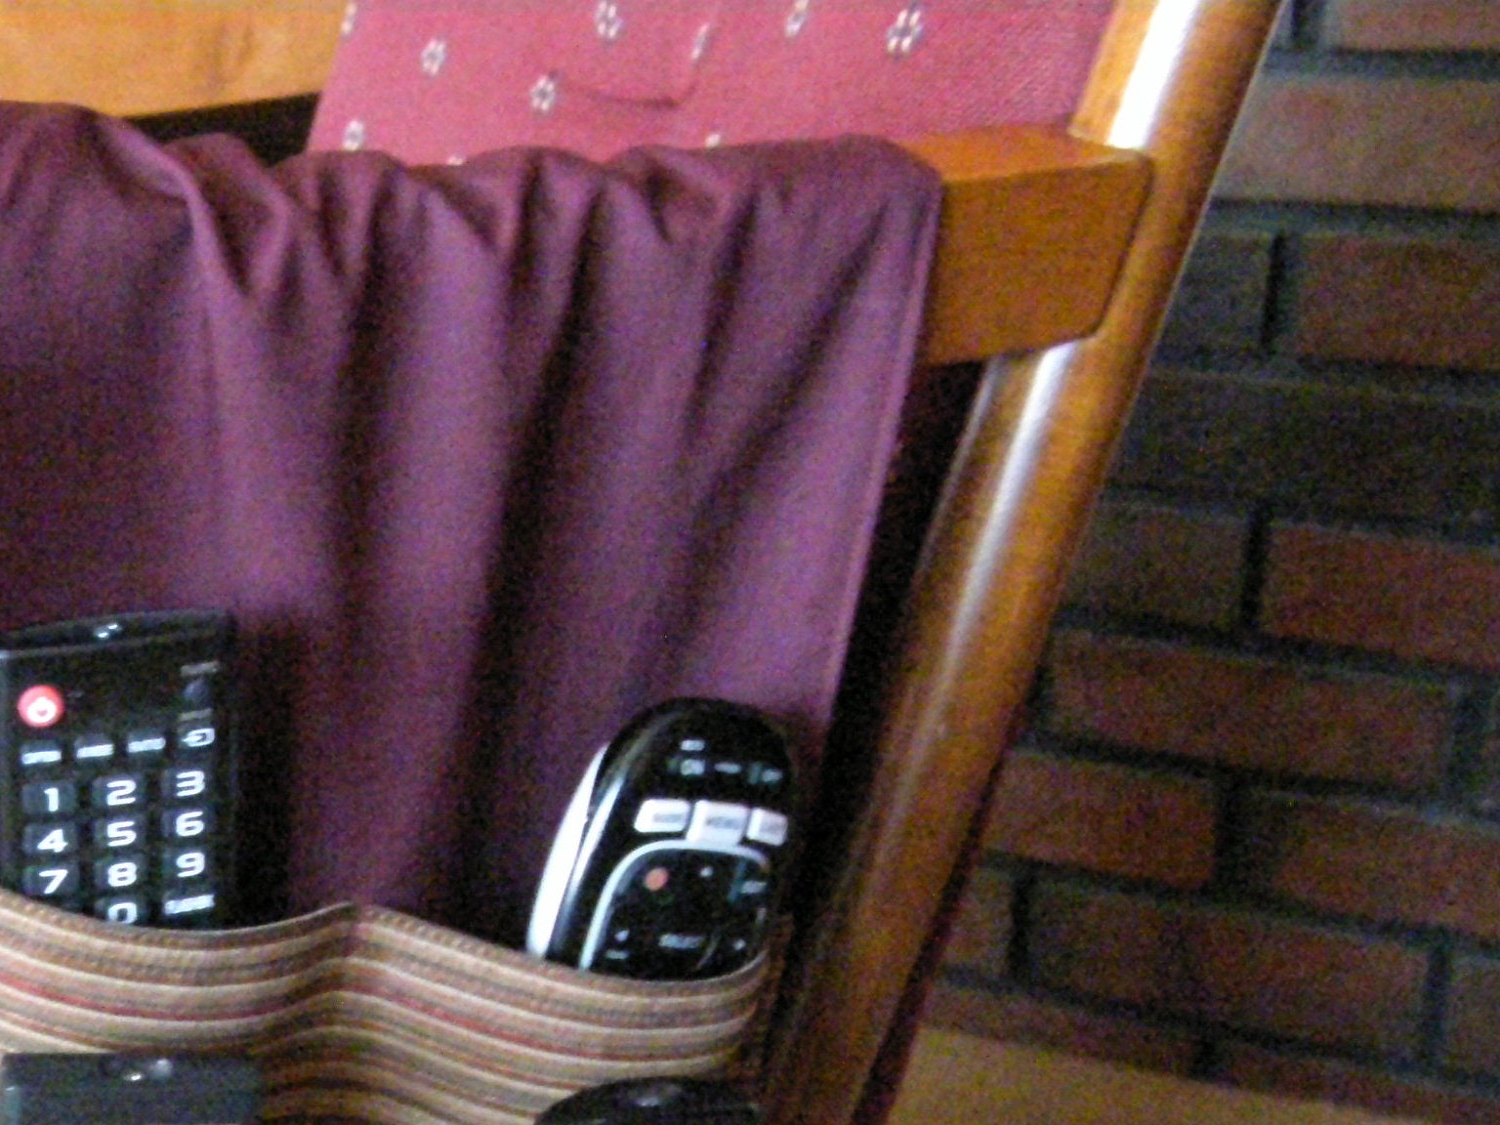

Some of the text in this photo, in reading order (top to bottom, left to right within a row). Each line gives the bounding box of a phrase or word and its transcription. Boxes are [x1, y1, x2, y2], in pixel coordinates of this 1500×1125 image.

[44, 770, 205, 812] 1 2 3
[37, 810, 204, 852] 4 5 6
[38, 852, 205, 894] 7 8 9
[107, 902, 137, 925] 0
